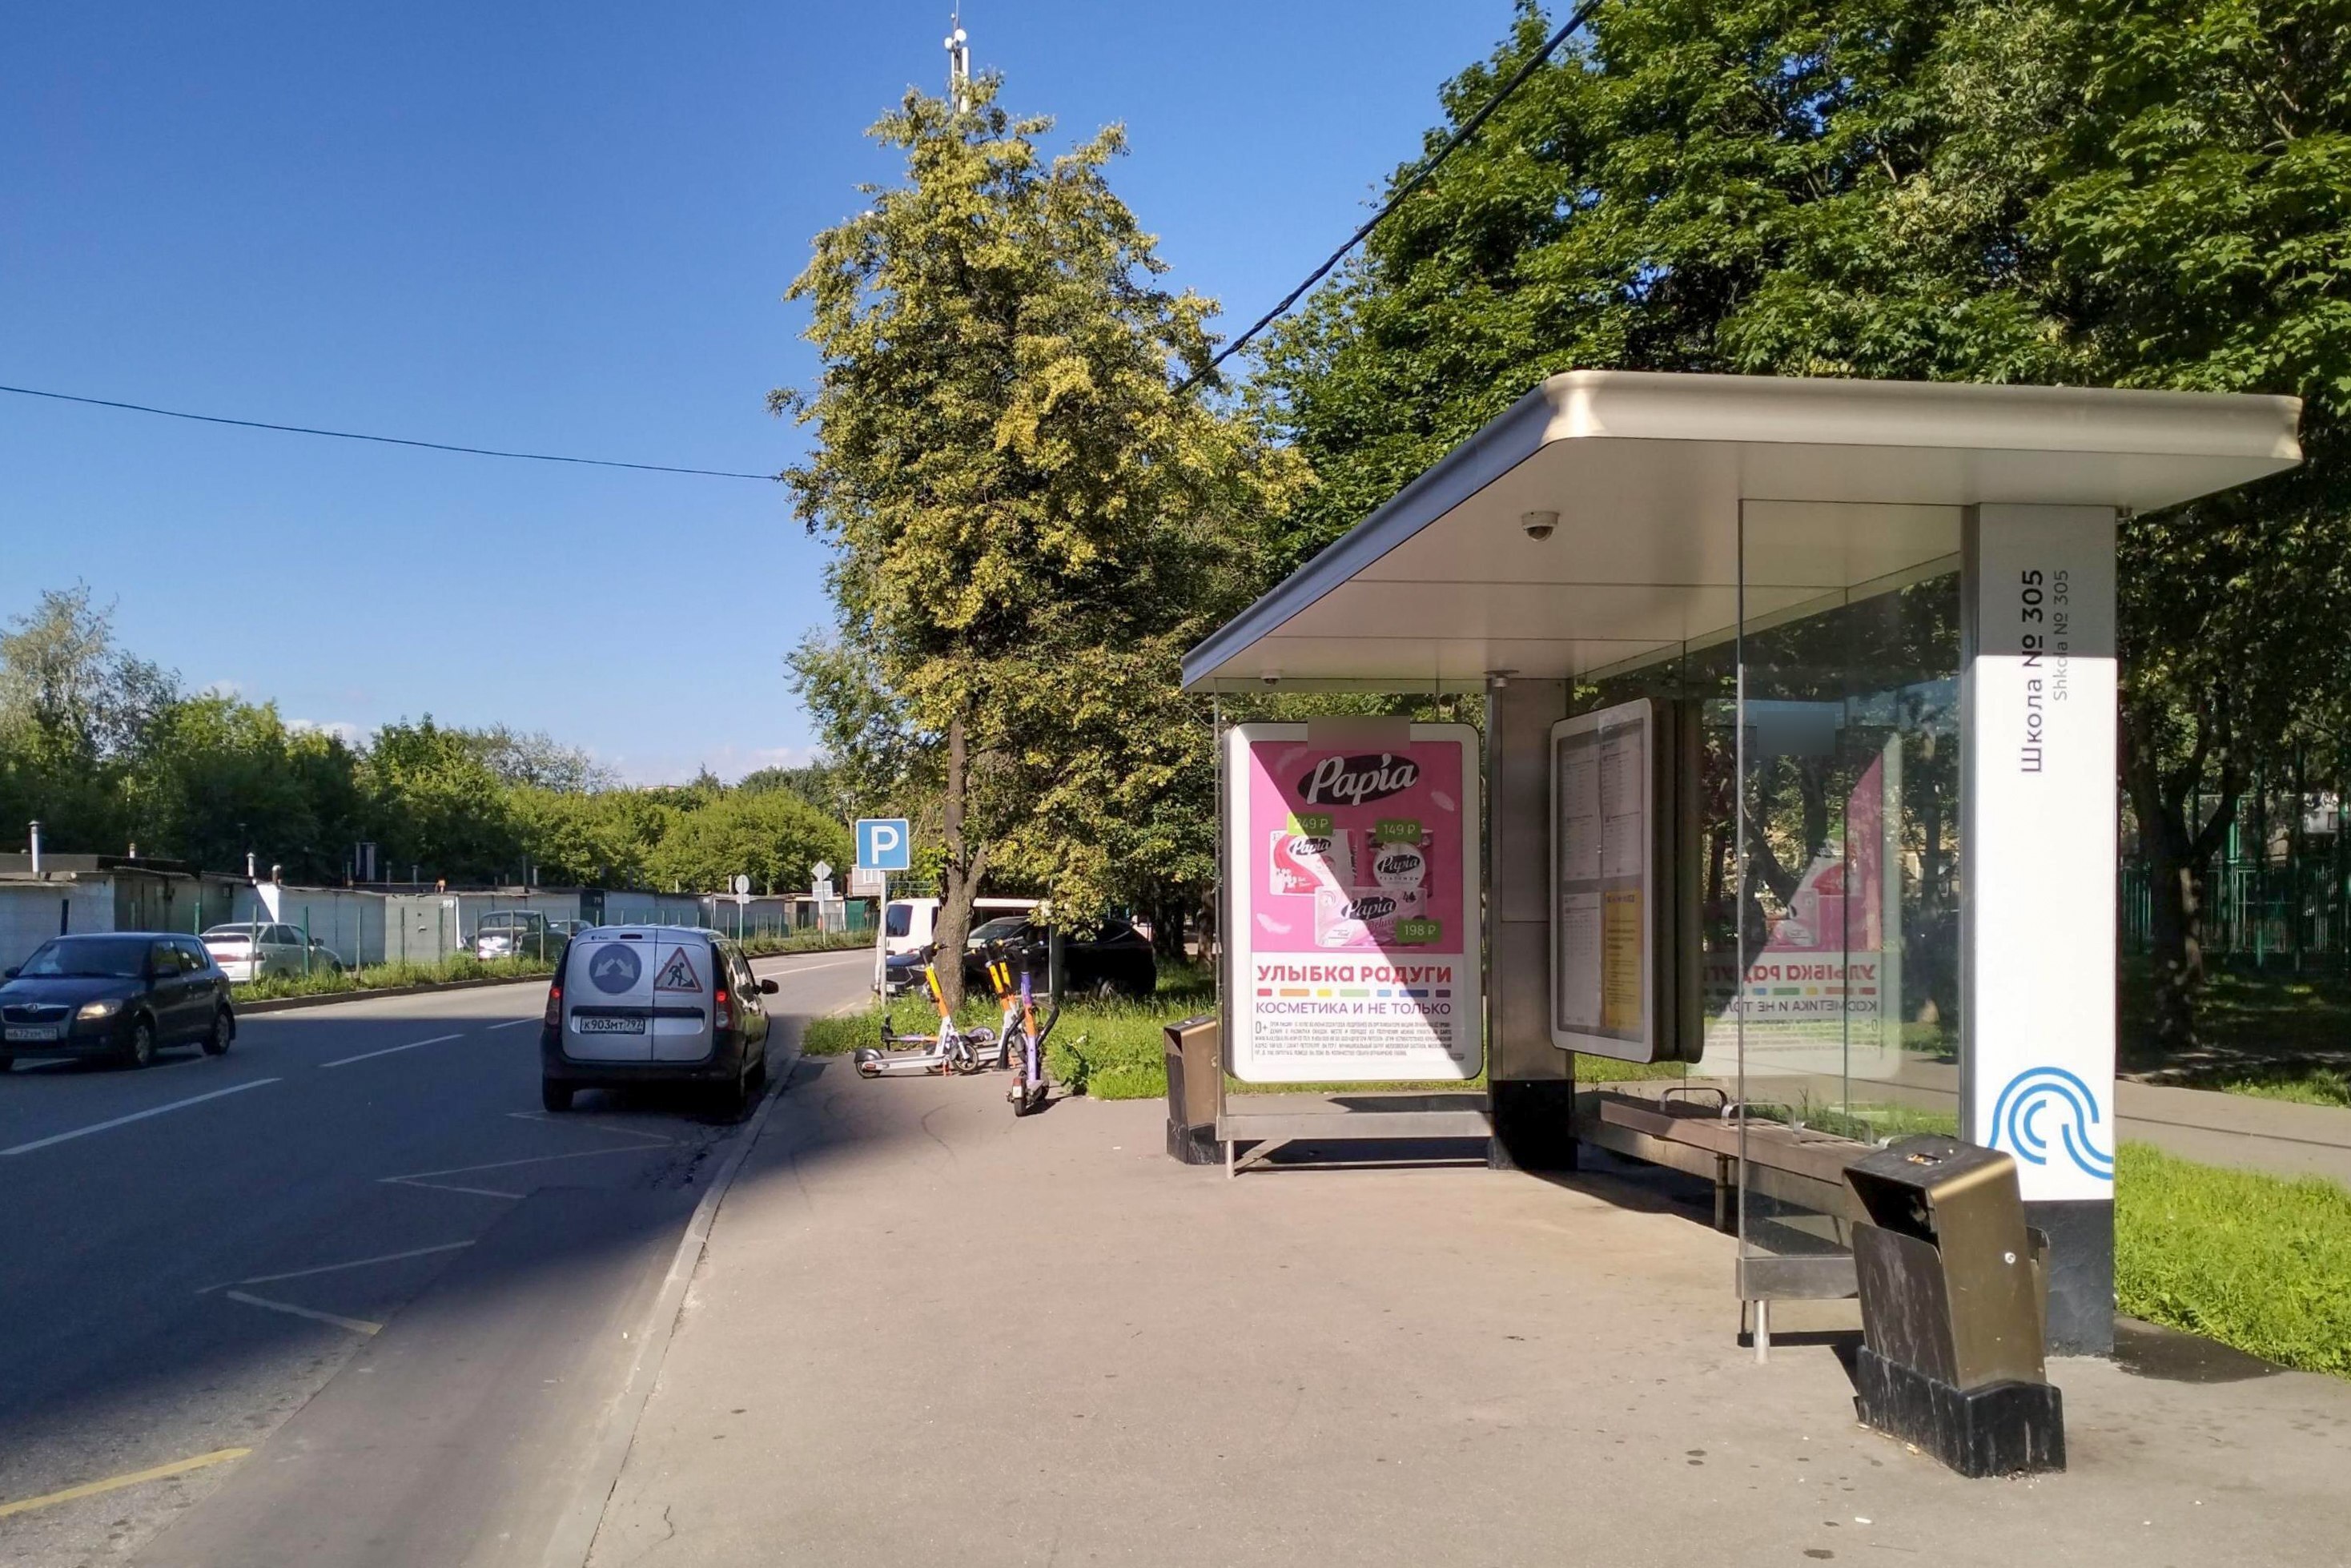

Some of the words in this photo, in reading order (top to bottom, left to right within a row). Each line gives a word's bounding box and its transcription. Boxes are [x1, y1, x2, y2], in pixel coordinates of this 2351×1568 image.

[2021, 569, 2044, 623] 305
[2053, 569, 2068, 605] 305
[2021, 633, 2044, 668] №
[2052, 641, 2068, 702] Shkola
[2020, 678, 2043, 773] Школа
[1306, 753, 1417, 806] Papia
[1384, 824, 1405, 835] 149
[1292, 838, 1330, 855] Papia
[1382, 854, 1419, 874] Papia
[1344, 896, 1394, 919] Papia
[1405, 925, 1425, 935] 198
[1256, 1002, 1348, 1015] КОСМЕТИКА
[1353, 1003, 1363, 1014] И
[1368, 1003, 1386, 1015] НЕ
[1391, 1003, 1451, 1015] ТОЛЬКО
[1255, 1021, 1268, 1034] 0+
